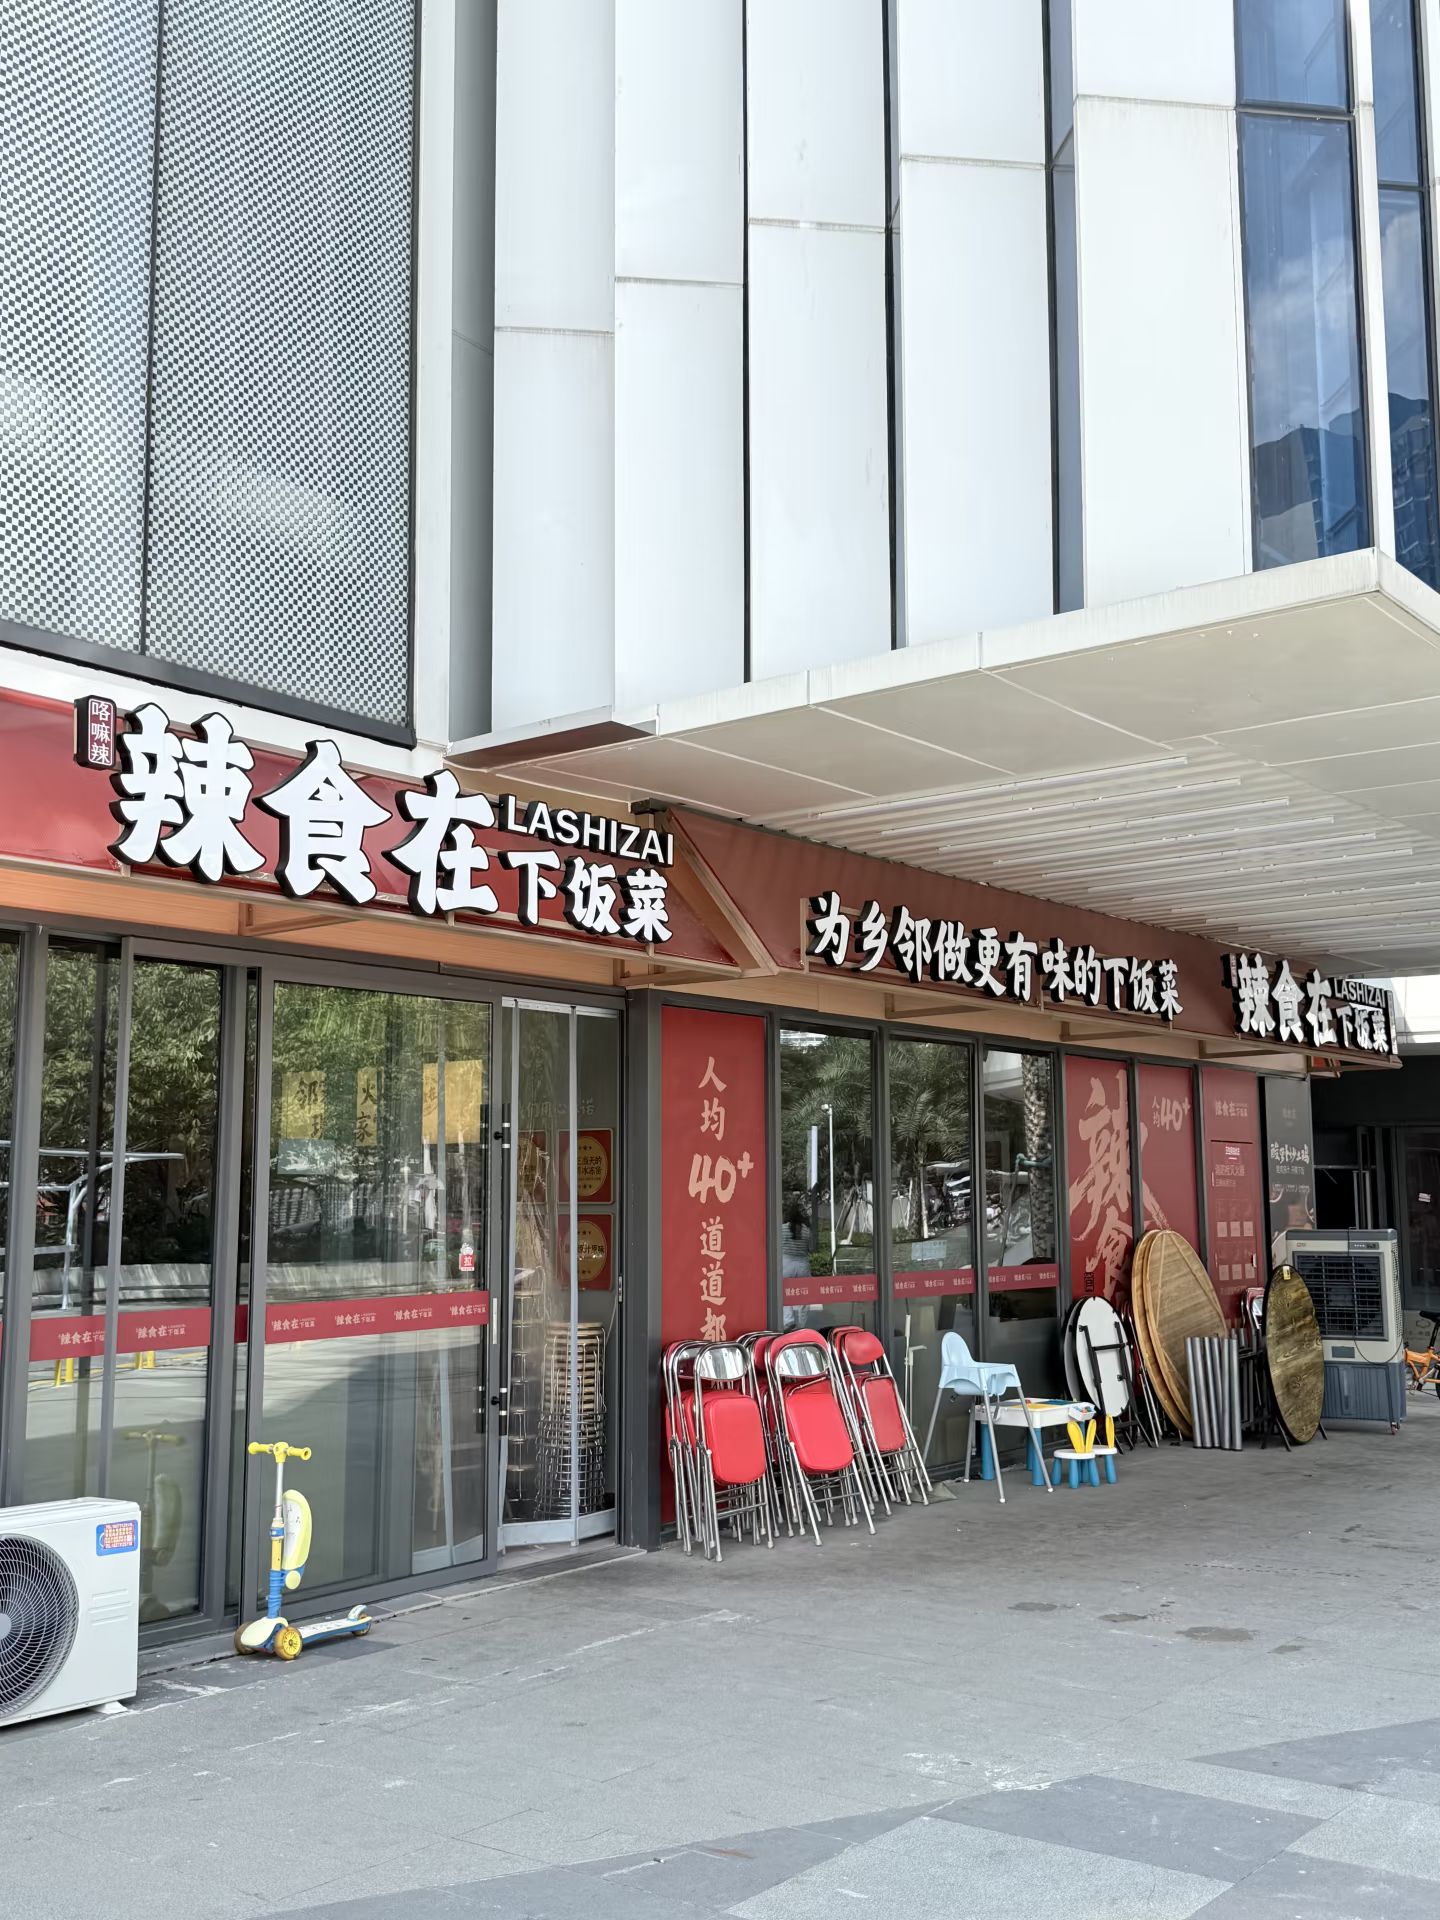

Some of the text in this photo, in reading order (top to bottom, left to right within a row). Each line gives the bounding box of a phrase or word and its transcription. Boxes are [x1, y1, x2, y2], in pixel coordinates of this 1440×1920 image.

[91, 701, 111, 764] 咯嘛辣
[112, 702, 499, 915] 辣食在
[506, 794, 673, 865] LASHIZAI
[503, 850, 673, 942] 下饭菜
[812, 891, 1184, 1021] 为乡邻做更有味的下饭菜
[1334, 978, 1386, 1008] LASHIZAI
[1236, 952, 1337, 1047] 辣食在
[1336, 1005, 1389, 1053] 下饭菜
